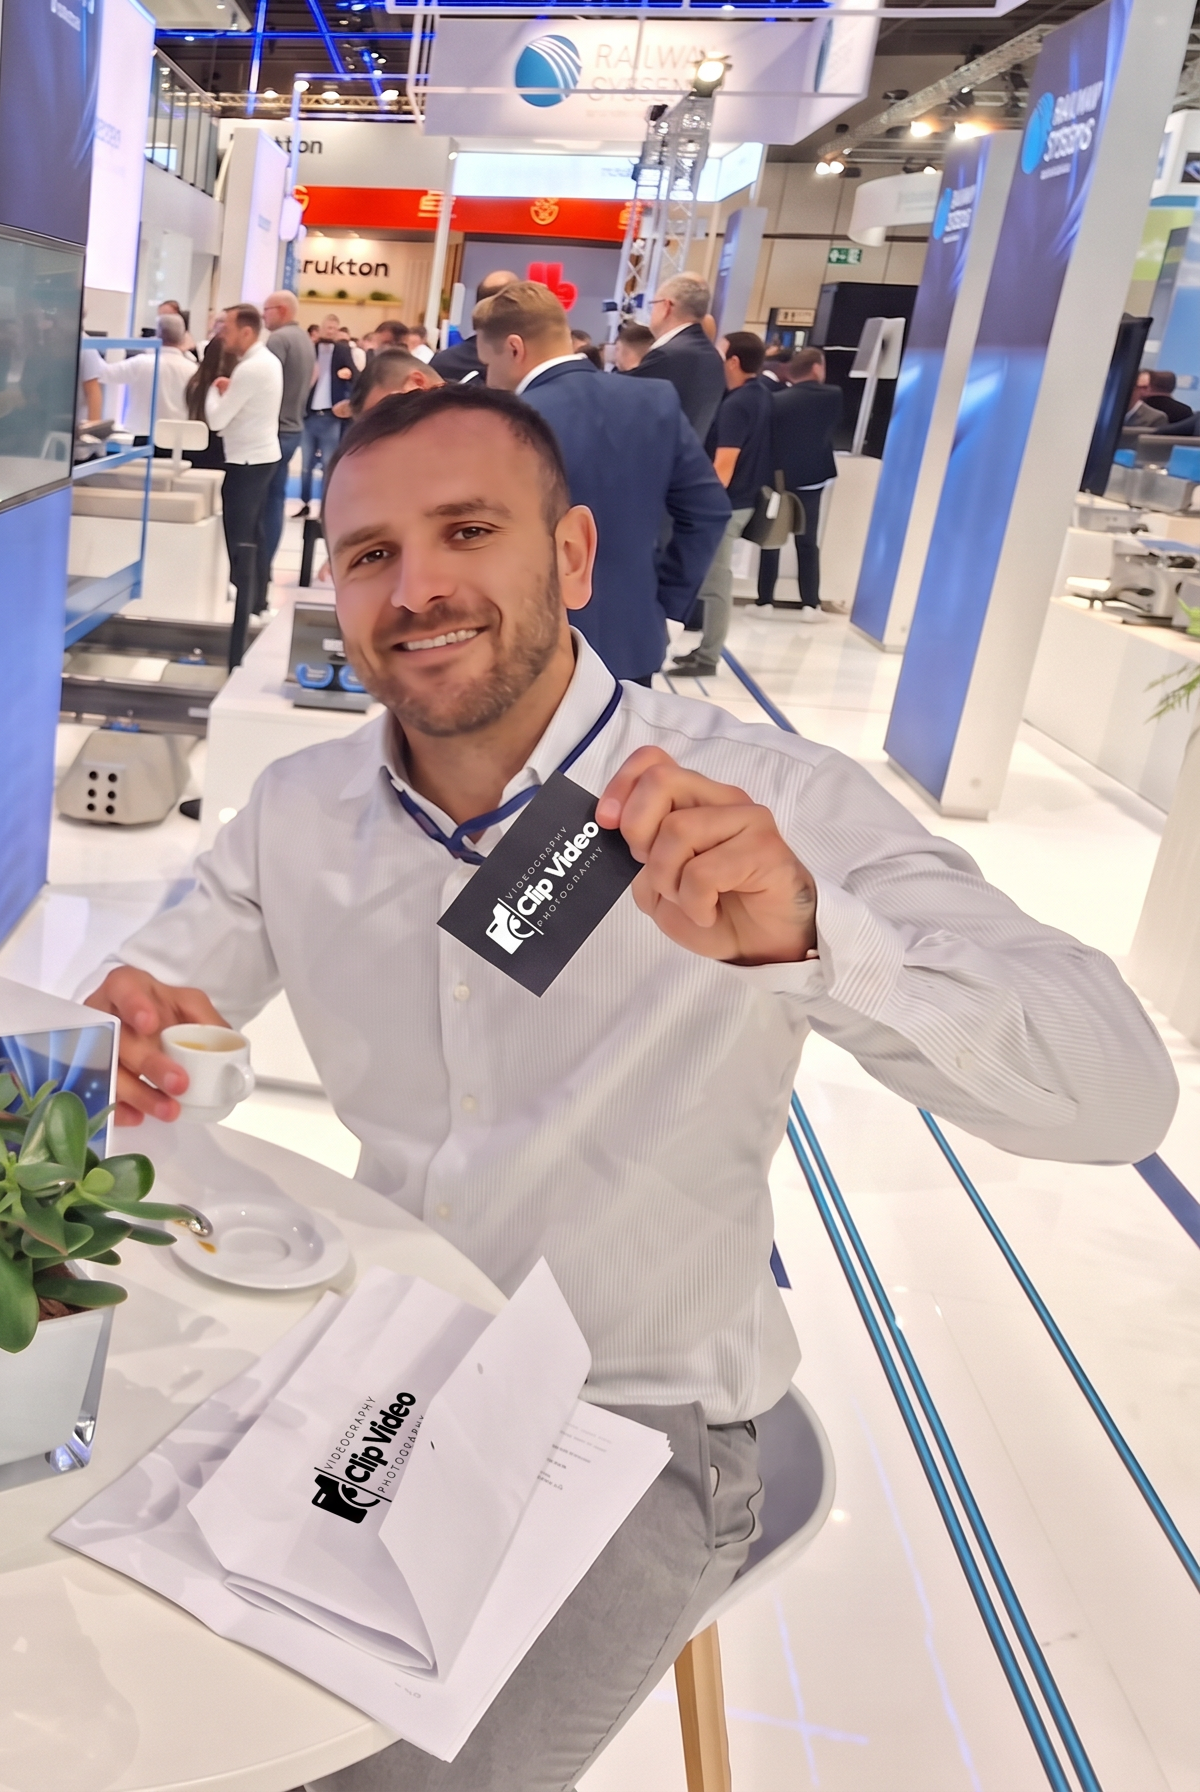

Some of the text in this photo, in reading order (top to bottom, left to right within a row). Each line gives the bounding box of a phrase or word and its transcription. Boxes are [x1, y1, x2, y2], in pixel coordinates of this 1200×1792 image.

[297, 255, 390, 277] rukton
[516, 821, 600, 916] Clip Video
[324, 1396, 376, 1470] VIDEOGRAPHY
[344, 1392, 417, 1483] Clip Video
